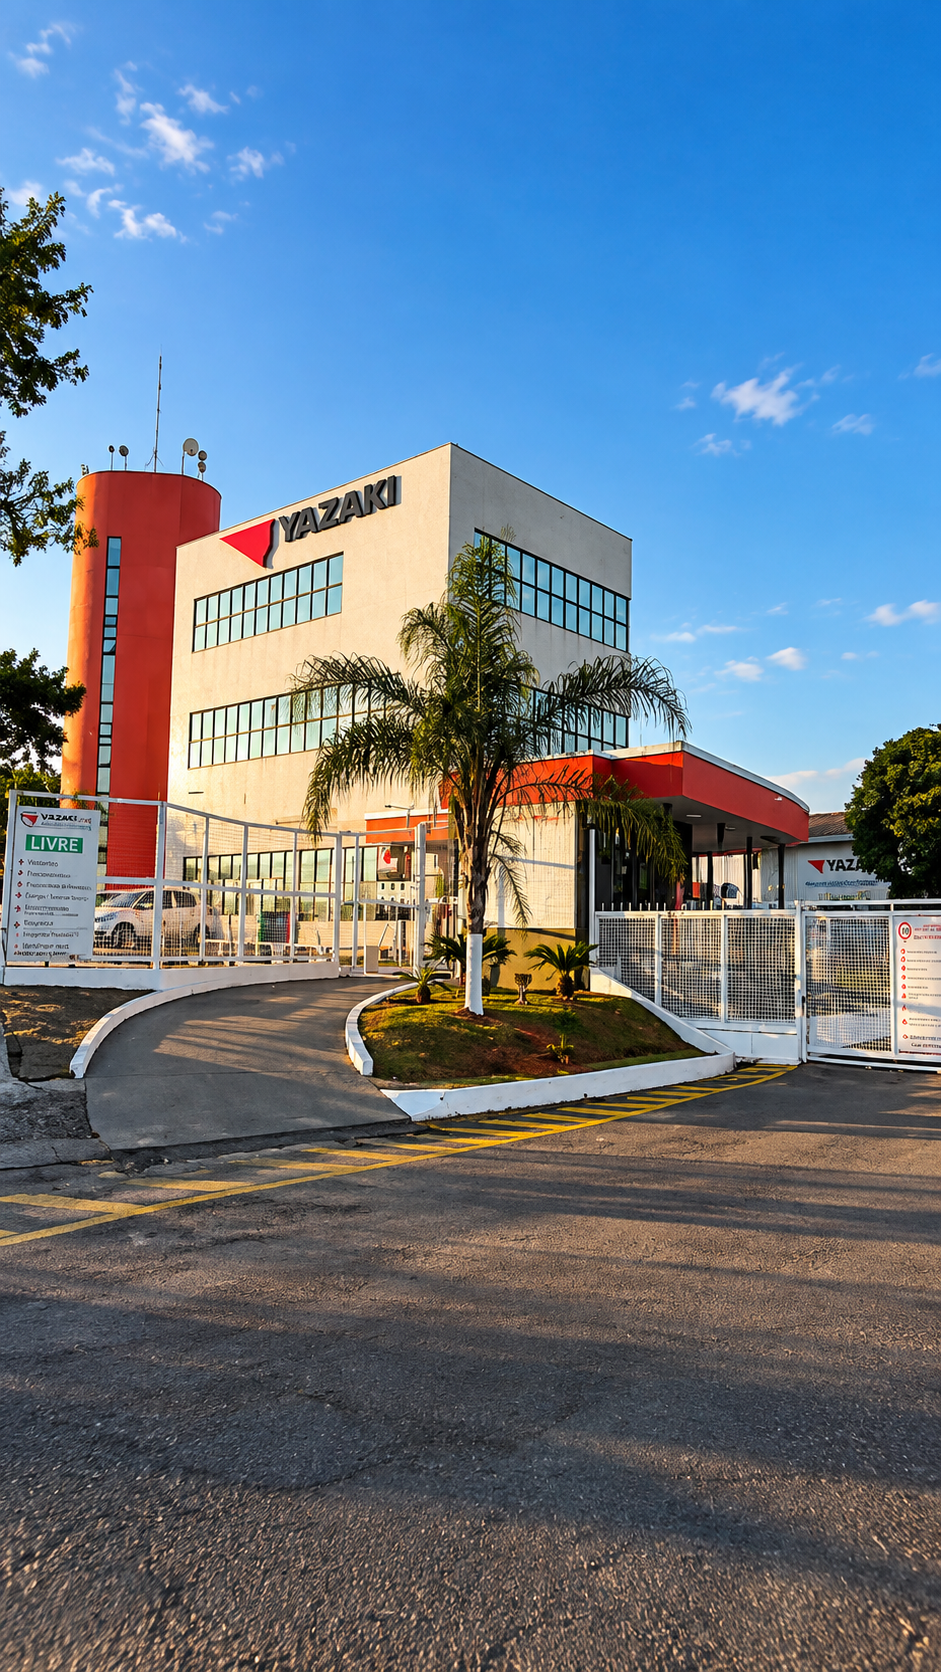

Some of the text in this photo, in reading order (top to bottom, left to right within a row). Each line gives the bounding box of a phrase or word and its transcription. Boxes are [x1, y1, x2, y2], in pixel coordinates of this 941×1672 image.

[278, 475, 398, 543] YAZAKI
[31, 836, 79, 852] LIVRE
[826, 859, 861, 871] YAZA
